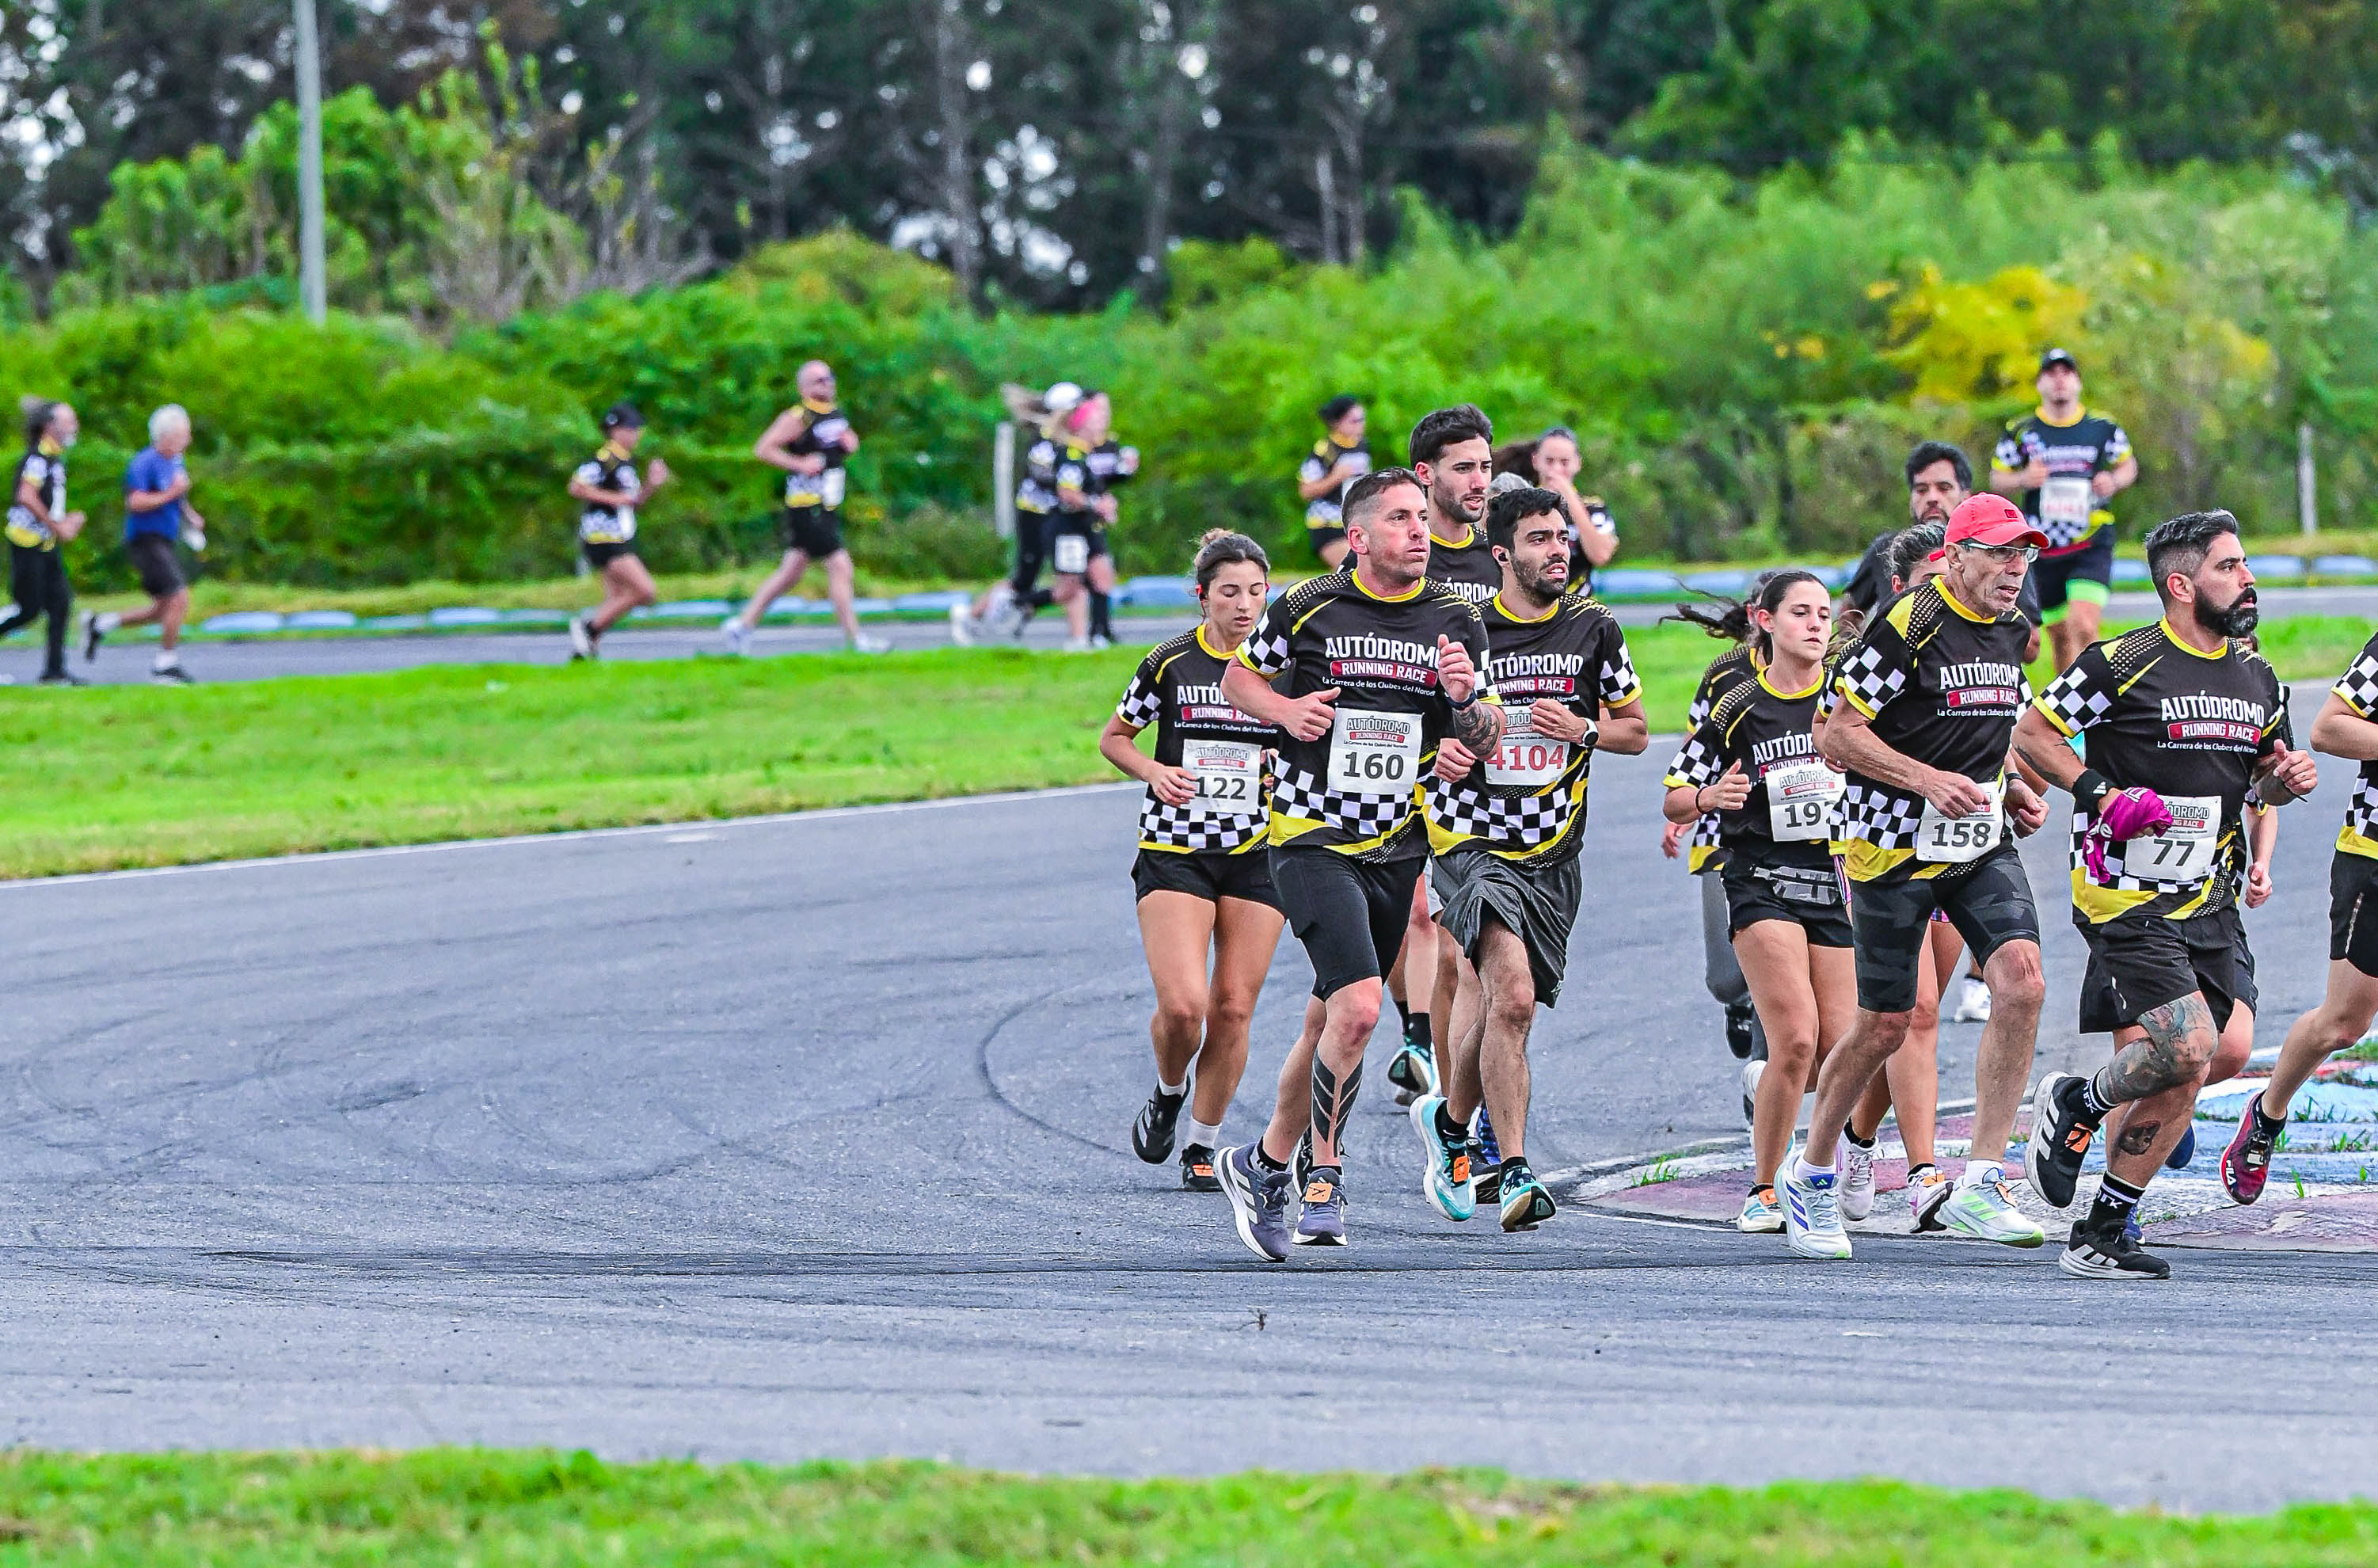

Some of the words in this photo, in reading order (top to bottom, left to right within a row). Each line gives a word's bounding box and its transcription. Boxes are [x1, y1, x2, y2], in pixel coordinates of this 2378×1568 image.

[1341, 662, 1394, 676] RUNNING
[1396, 665, 1428, 683] RACE
[1490, 652, 1584, 679] TÓDROMO
[1939, 657, 2020, 691] AUTÓDROM
[1330, 678, 1355, 687] Carrera
[1497, 679, 1535, 695] UNNING
[1538, 679, 1567, 692] RACE
[1959, 690, 1998, 705] RUNNING
[1191, 707, 1233, 719] RUNNING
[2160, 690, 2265, 729] AUTÓDROMO
[1346, 715, 1410, 734] AUTÓDROMO
[2182, 723, 2227, 737] RUNNING
[2228, 725, 2255, 742] RACE
[2167, 741, 2193, 750] Carrera
[1343, 752, 1404, 780] 160
[1486, 744, 1564, 771] 4104
[1194, 776, 1246, 800] 122
[1932, 822, 1991, 848] 158
[2153, 839, 2195, 866] 77
